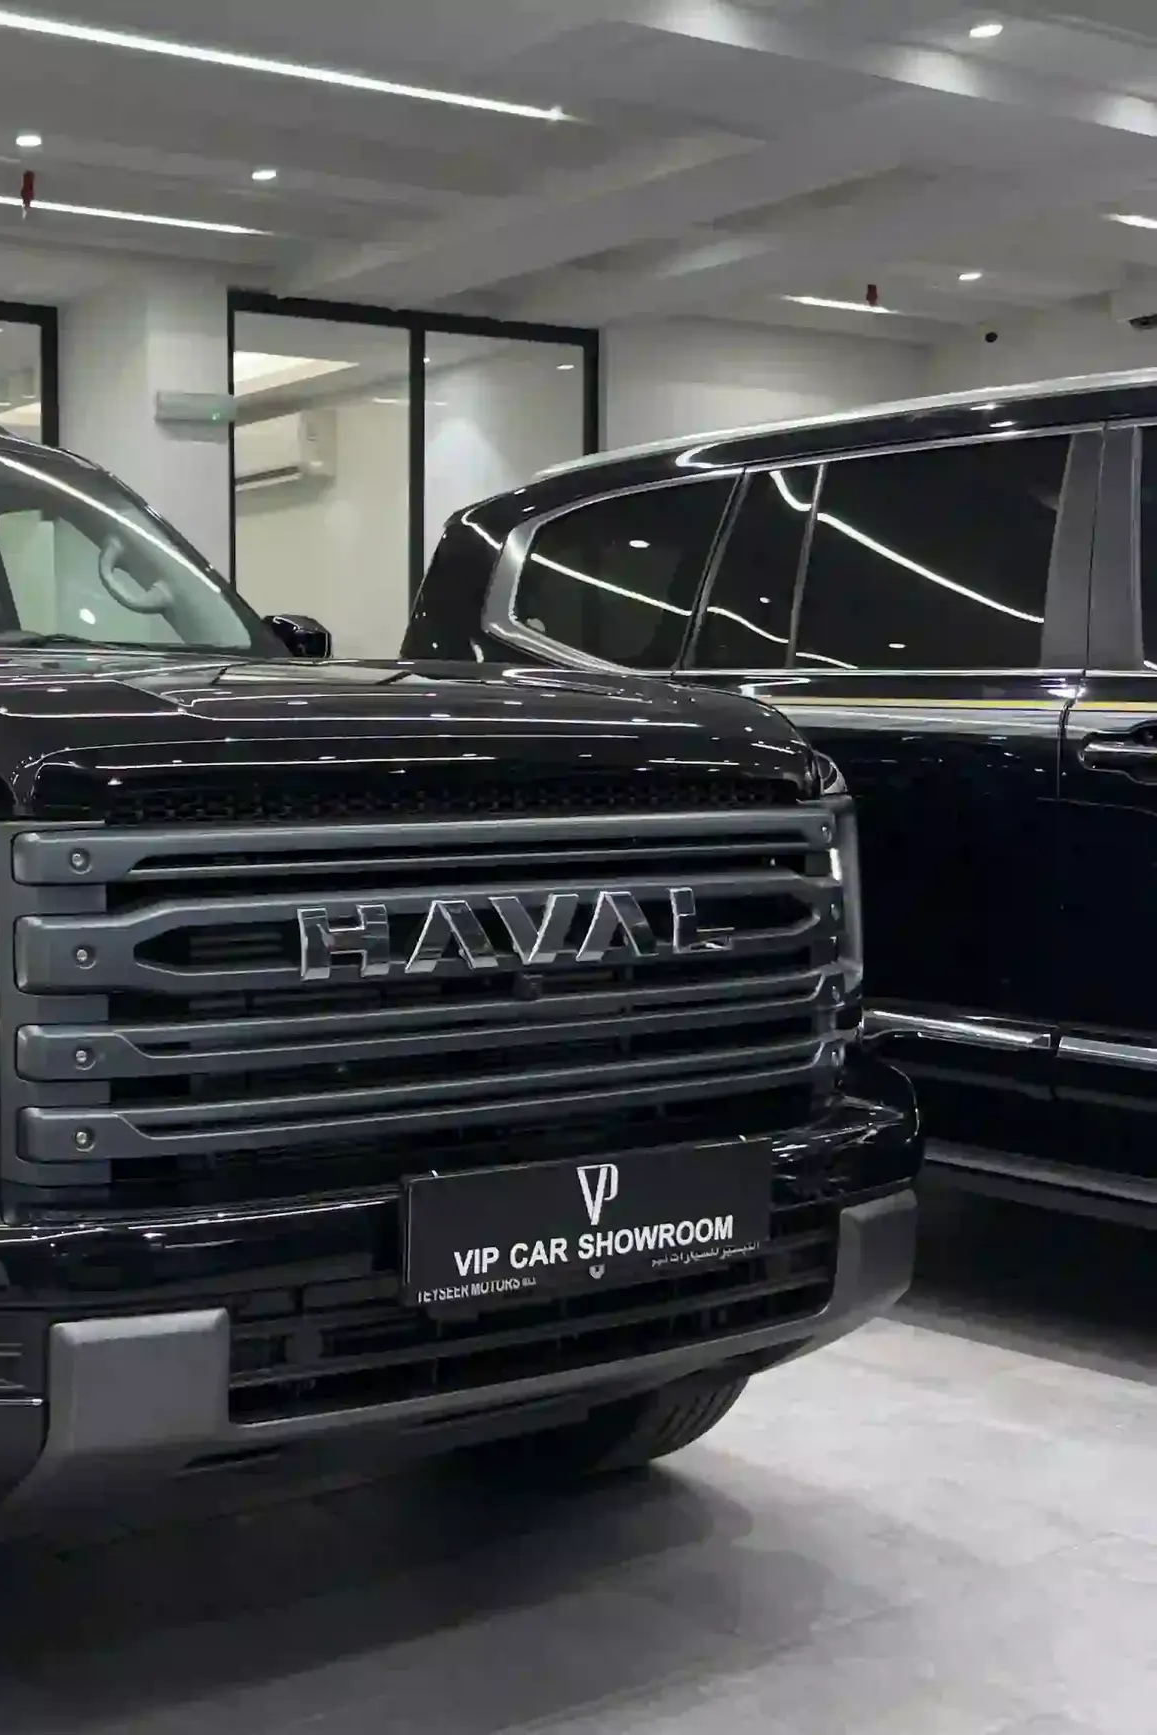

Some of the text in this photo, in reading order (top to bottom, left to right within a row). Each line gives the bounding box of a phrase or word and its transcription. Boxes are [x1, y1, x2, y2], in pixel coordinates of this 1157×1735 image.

[297, 888, 734, 980] HAVAL
[453, 1246, 500, 1277] VIP
[509, 1237, 569, 1269] CAR
[577, 1214, 734, 1260] SHOWROOM
